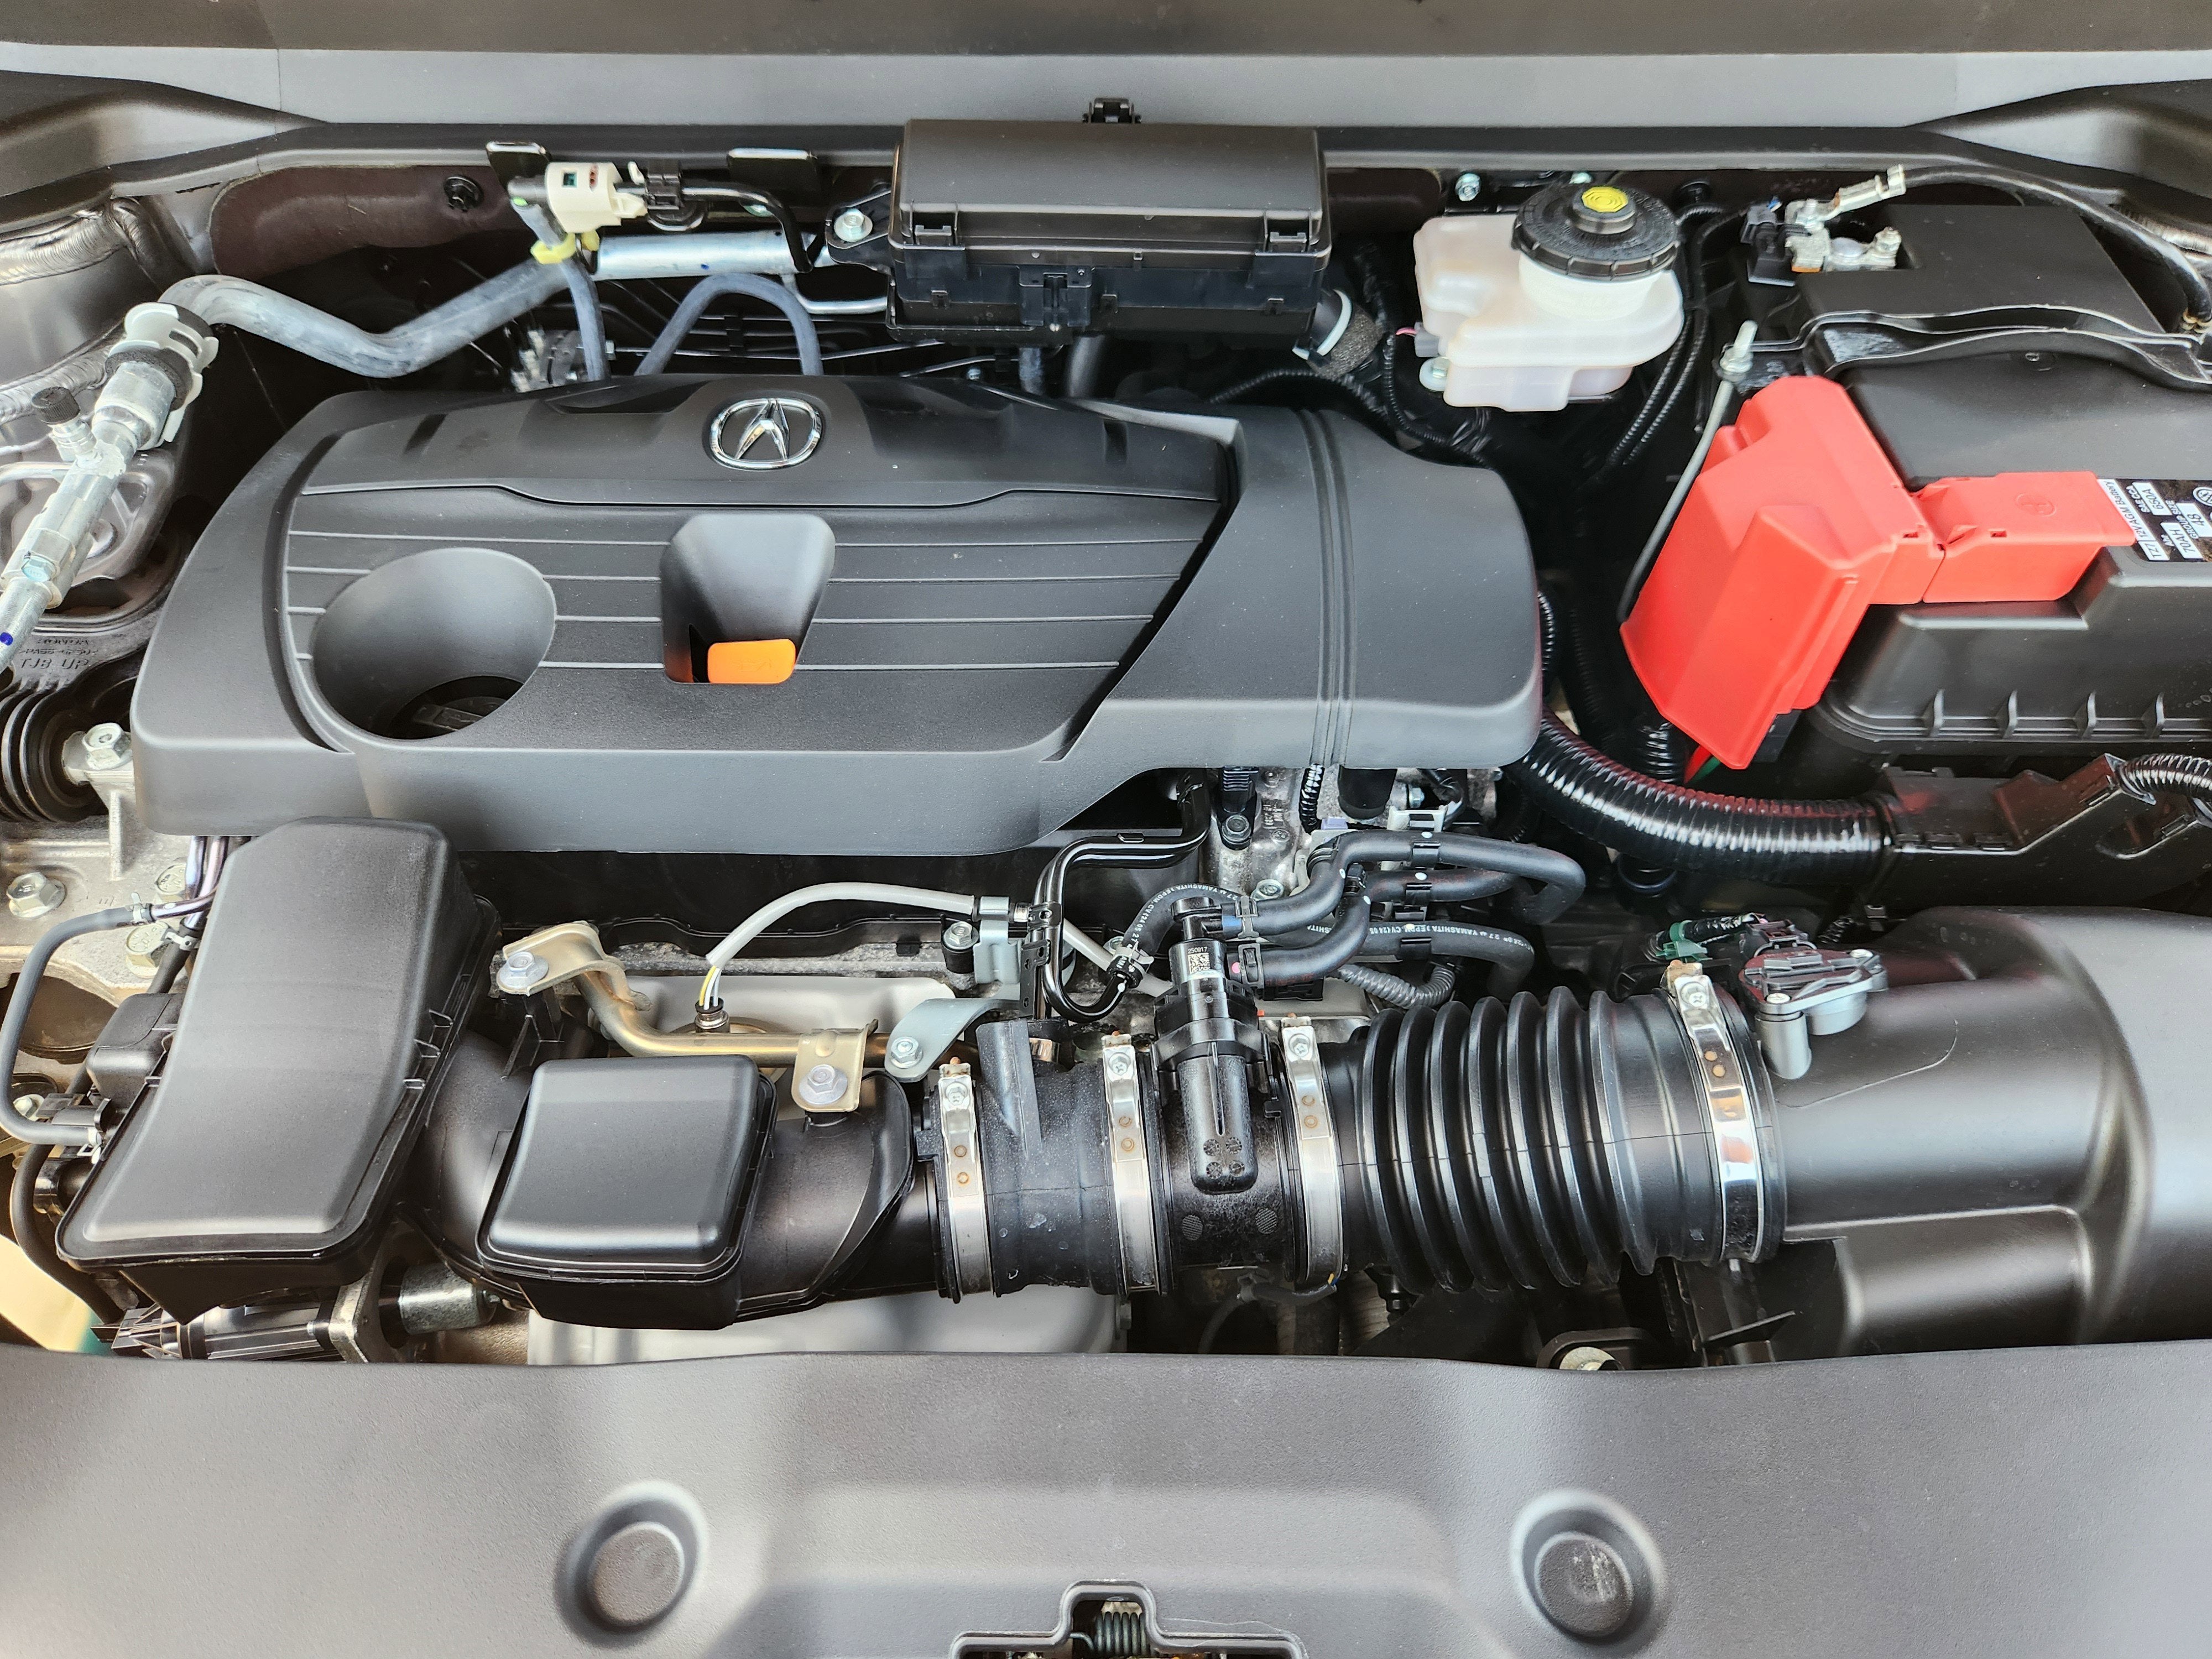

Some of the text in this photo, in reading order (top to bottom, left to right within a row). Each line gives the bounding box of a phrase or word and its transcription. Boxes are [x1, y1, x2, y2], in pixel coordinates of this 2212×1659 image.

[2103, 481, 2125, 505] Battery
[2126, 485, 2151, 513] SAE CCA
[2141, 489, 2164, 509] 650A
[2119, 507, 2140, 526] AGM
[2165, 499, 2199, 539] GROUP SIZE
[2187, 514, 2205, 526] 48
[2145, 542, 2162, 557] TZ7
[2169, 529, 2196, 553] 70AH
[61, 658, 89, 669] UP
[1175, 884, 1218, 892] YAMASHITA
[1431, 925, 1479, 936] YAMASHITA
[1187, 946, 1208, 954] 250917
